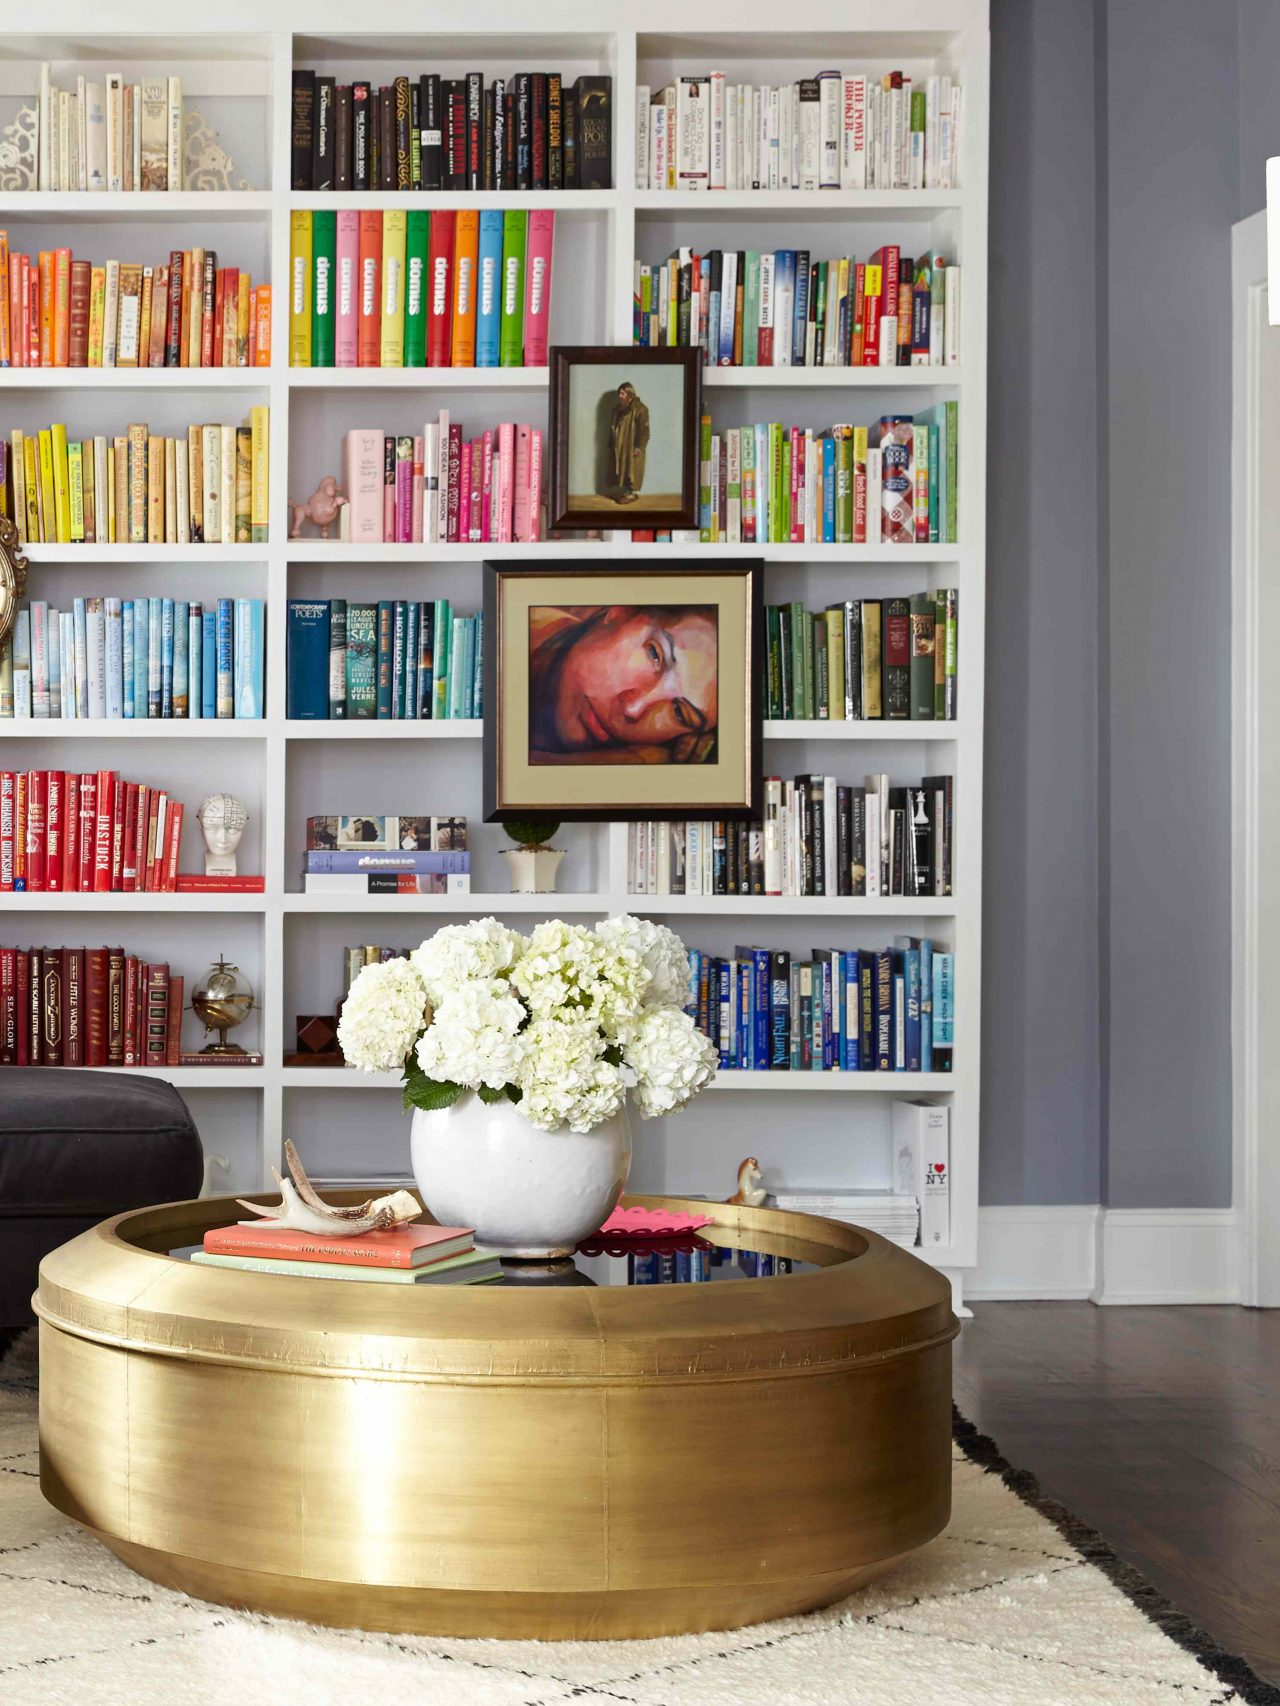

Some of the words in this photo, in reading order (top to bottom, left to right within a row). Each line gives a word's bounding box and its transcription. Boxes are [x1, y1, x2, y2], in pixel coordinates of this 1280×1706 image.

[550, 78, 560, 106] SIDNEY
[844, 80, 854, 130] BROKER
[550, 110, 560, 146] SHELDON
[854, 110, 864, 152] POWER
[888, 247, 898, 281] PRIMARY
[294, 257, 306, 315] domus
[316, 257, 330, 315] domus
[340, 258, 353, 316] domus
[363, 258, 377, 316] domus
[387, 258, 400, 316] domus
[409, 258, 423, 316] domus
[434, 258, 448, 316] domus
[458, 258, 472, 316] domus
[482, 258, 494, 316] domus
[506, 258, 519, 315] domus
[531, 257, 546, 314] domus
[888, 283, 898, 316] COLORS
[731, 434, 739, 460] Juicing
[838, 470, 848, 498] cook
[856, 476, 865, 492] fresh
[857, 493, 865, 508] food
[351, 630, 376, 641] SEA
[220, 640, 231, 672] HOUSE
[2, 797, 13, 836] JOHANSEN
[83, 837, 92, 864] Timothy
[96, 816, 110, 870] UNSTUCK
[2, 840, 13, 884] QUICKSAND
[720, 972, 728, 995] BRAIN
[879, 958, 890, 982] SANDRA
[880, 984, 890, 1010] BROWN
[69, 1008, 78, 1040] WOMEN
[879, 1014, 890, 1054] UNSPEAKABLE
[926, 1174, 946, 1184] NY
[928, 1164, 932, 1173] I
